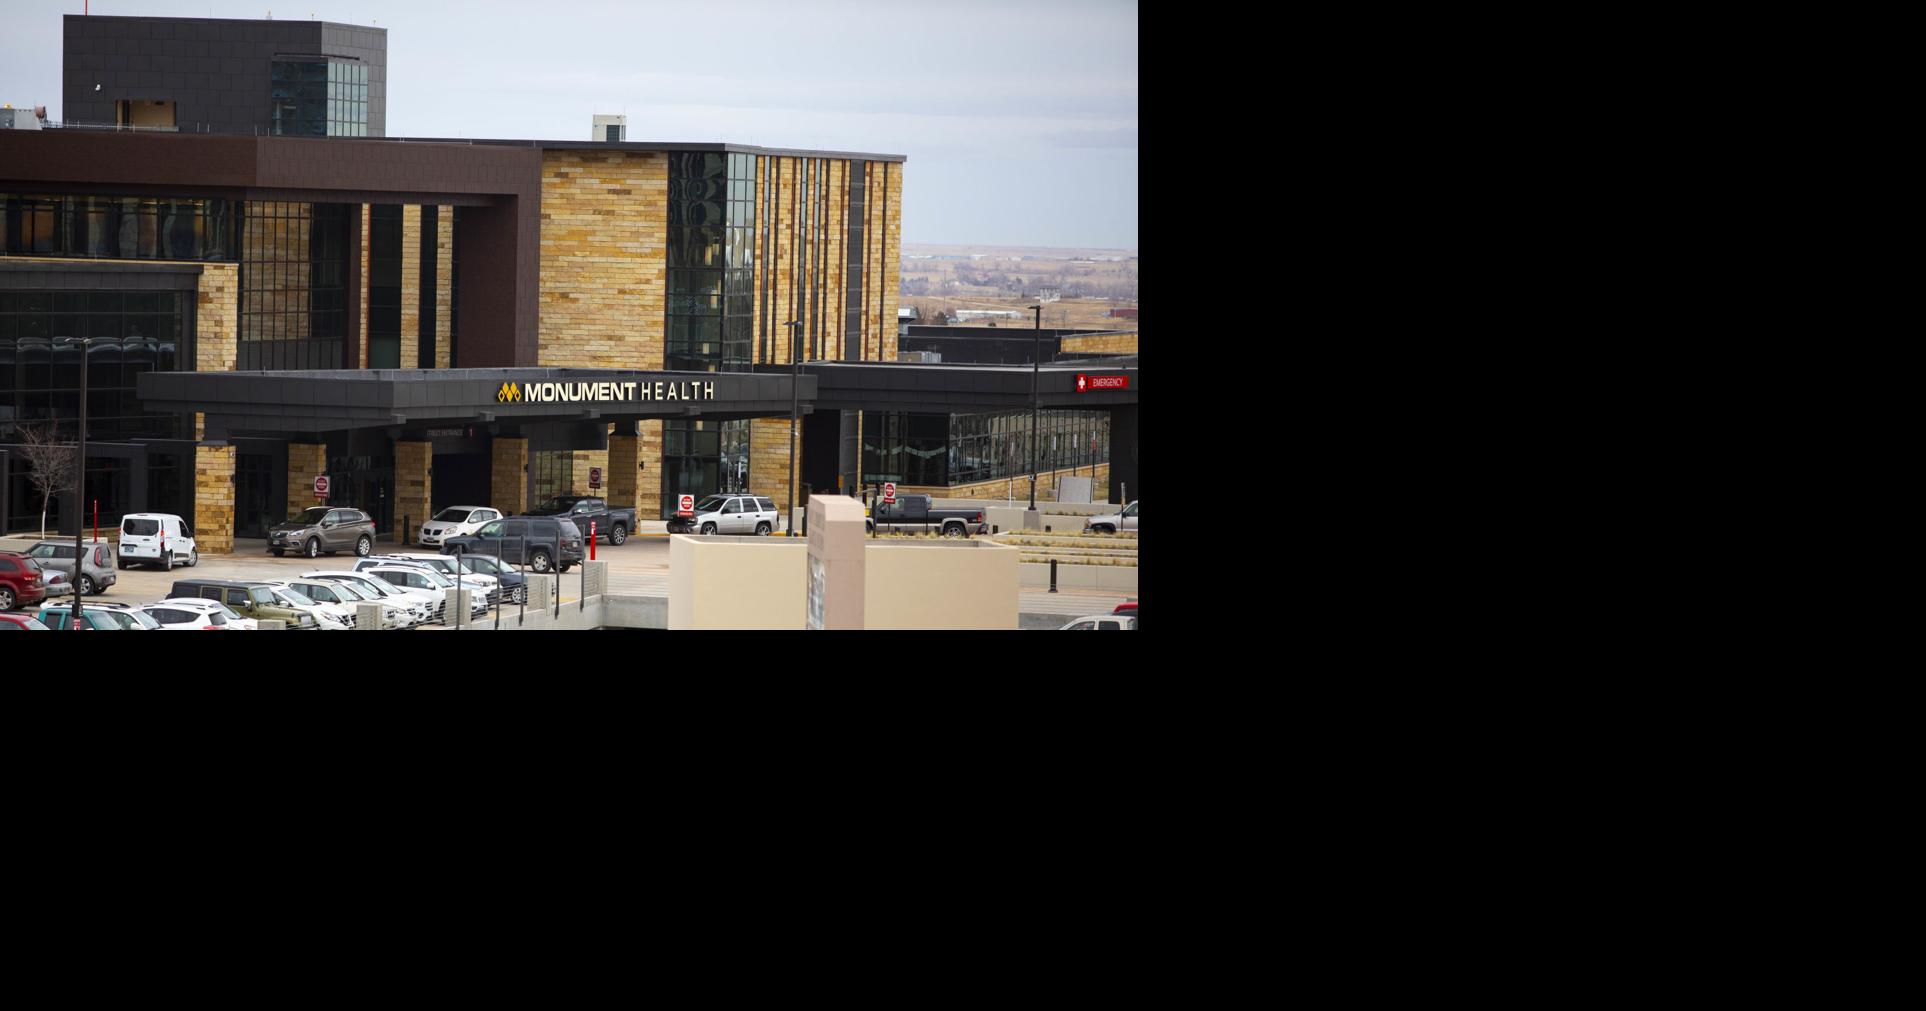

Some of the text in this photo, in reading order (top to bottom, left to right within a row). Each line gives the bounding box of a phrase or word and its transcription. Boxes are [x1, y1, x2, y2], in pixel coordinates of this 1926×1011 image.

[1093, 378, 1123, 387] EMERGENCY
[525, 381, 714, 402] MONUMENT HEALTH
